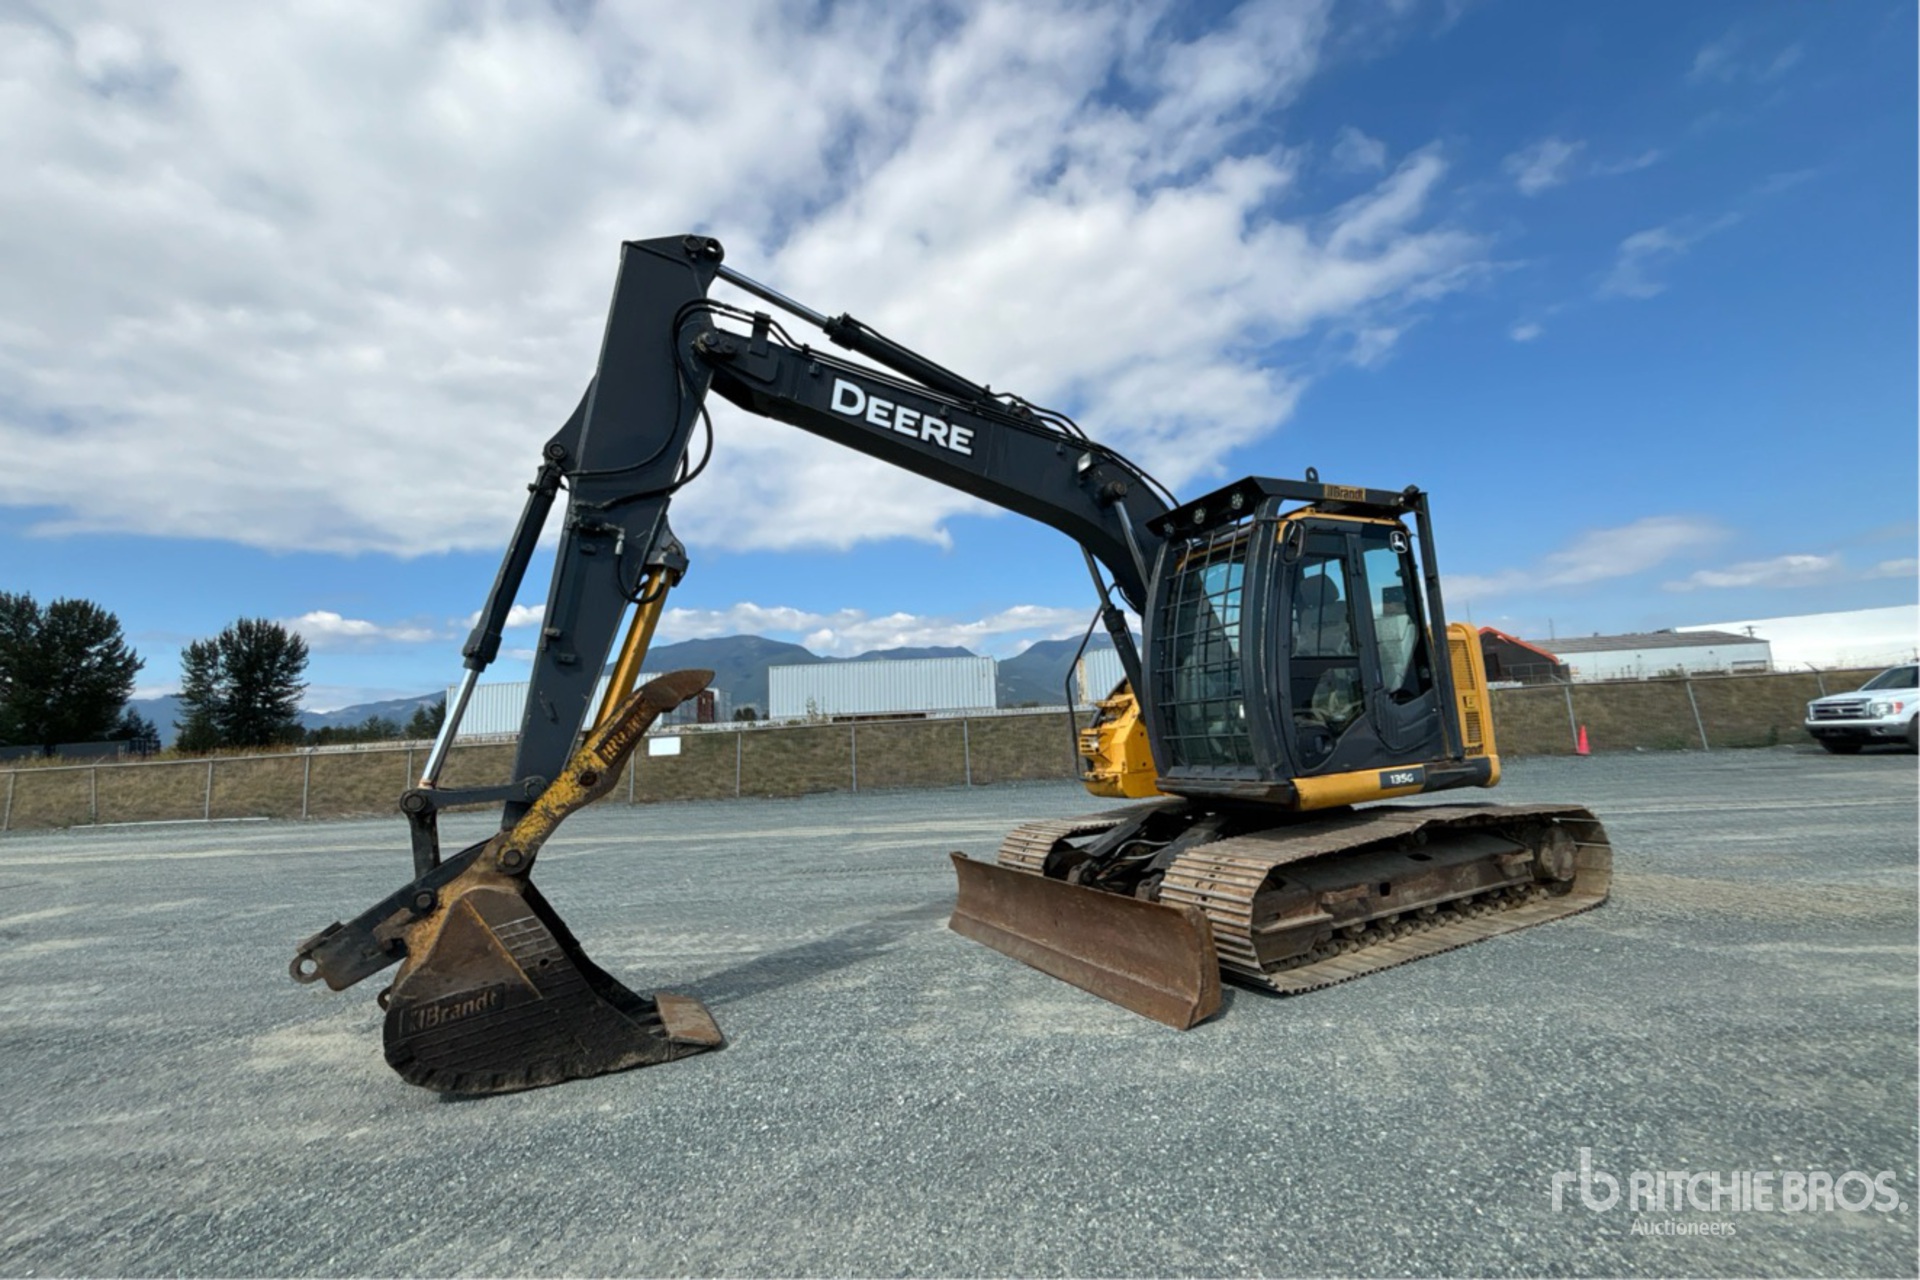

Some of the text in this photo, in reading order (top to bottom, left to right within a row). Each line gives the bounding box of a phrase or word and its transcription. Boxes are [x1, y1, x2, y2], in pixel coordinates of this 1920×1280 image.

[831, 378, 974, 455] DEERE
[1390, 772, 1414, 785] 135G
[427, 990, 497, 1027] Brandt
